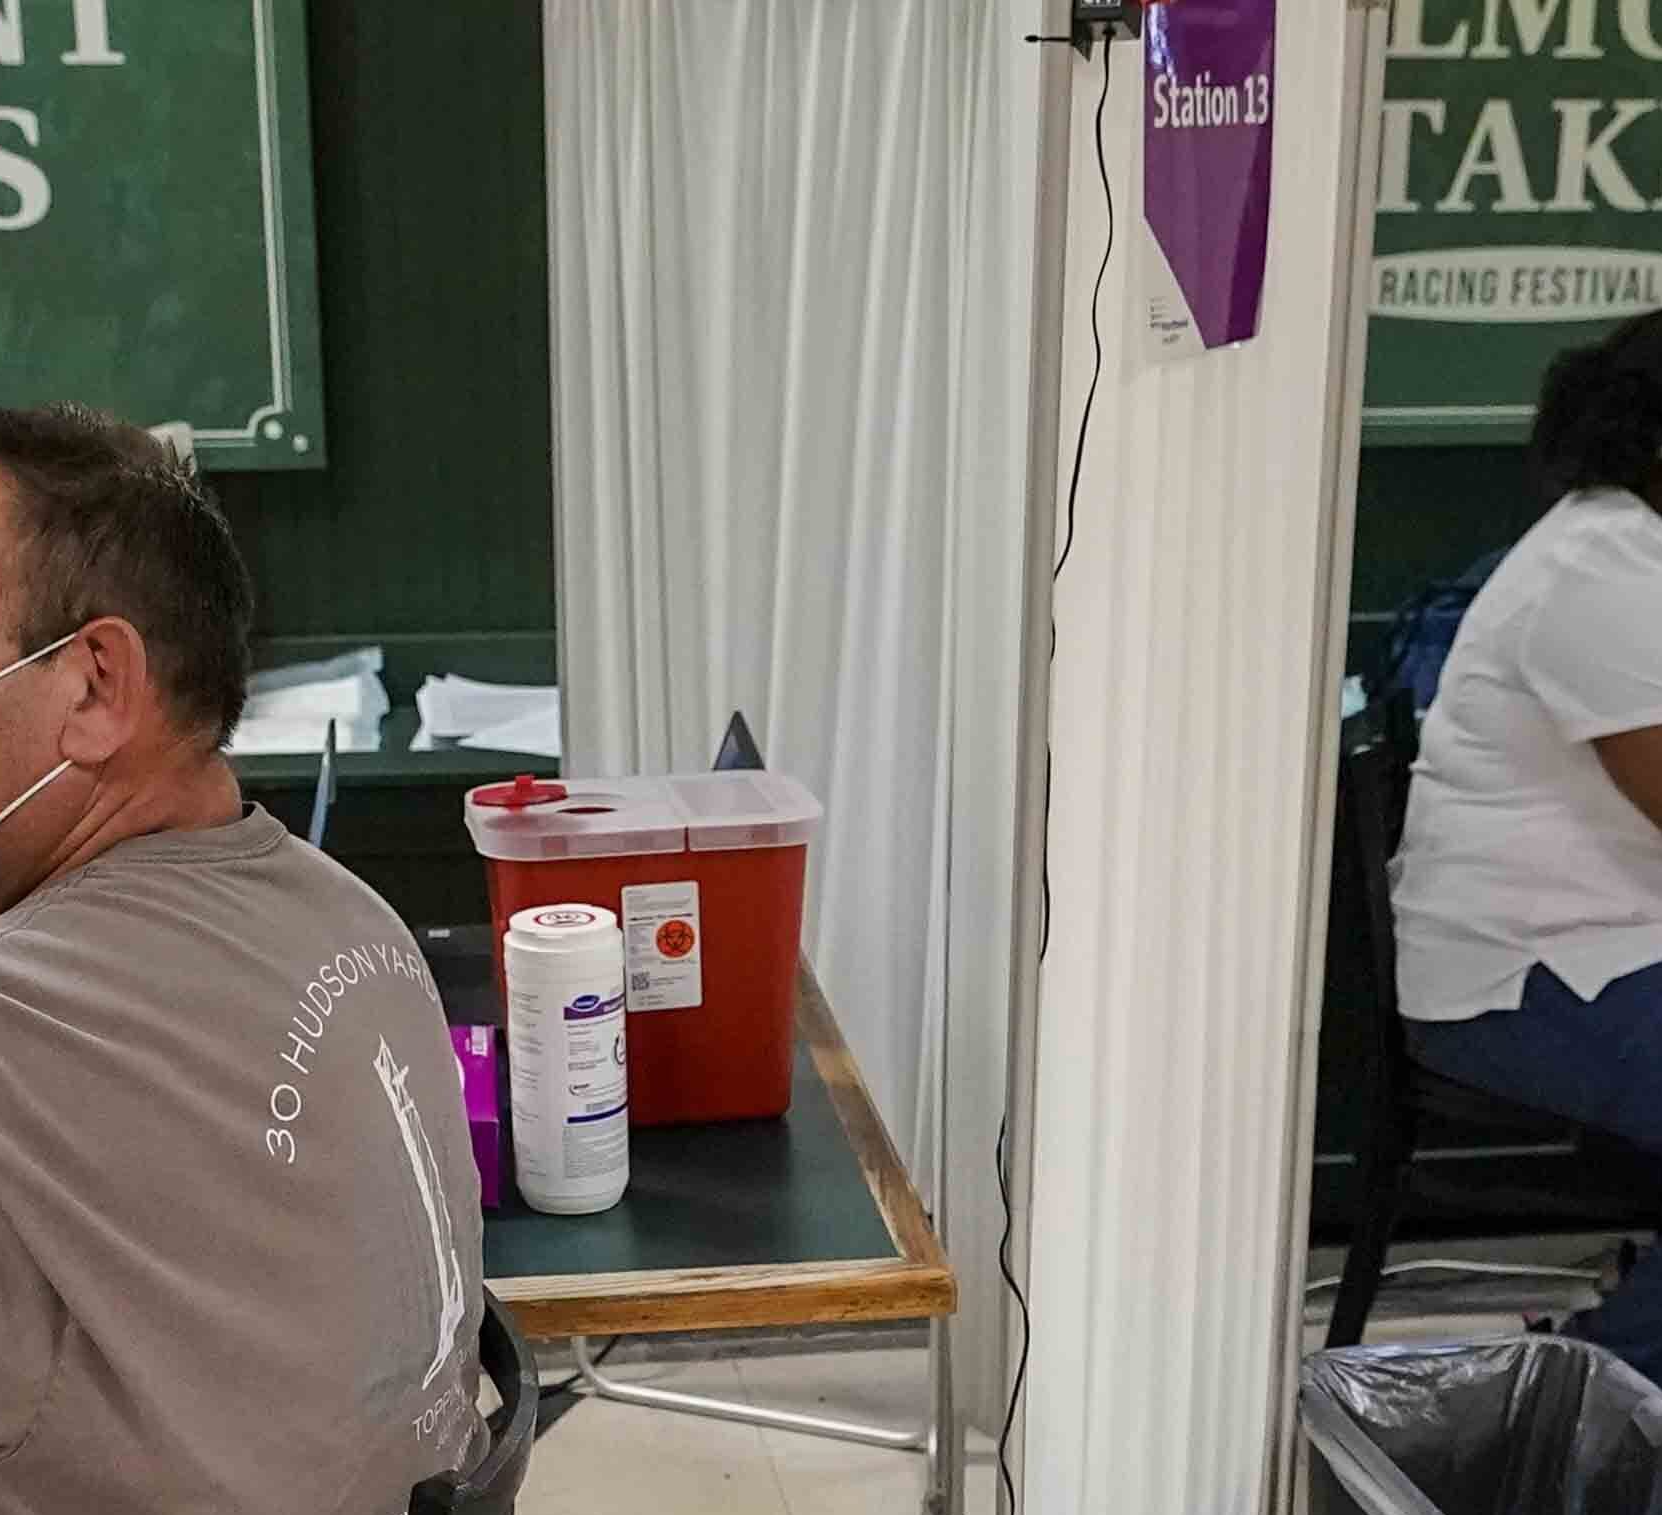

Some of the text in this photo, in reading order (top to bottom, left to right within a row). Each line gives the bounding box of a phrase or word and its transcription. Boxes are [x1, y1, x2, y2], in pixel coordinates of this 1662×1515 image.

[1153, 70, 1270, 129] Station 13
[1380, 265, 1661, 306] RACING FESTIVAL
[280, 945, 377, 1075] HUDSON
[265, 1084, 302, 1163] 30
